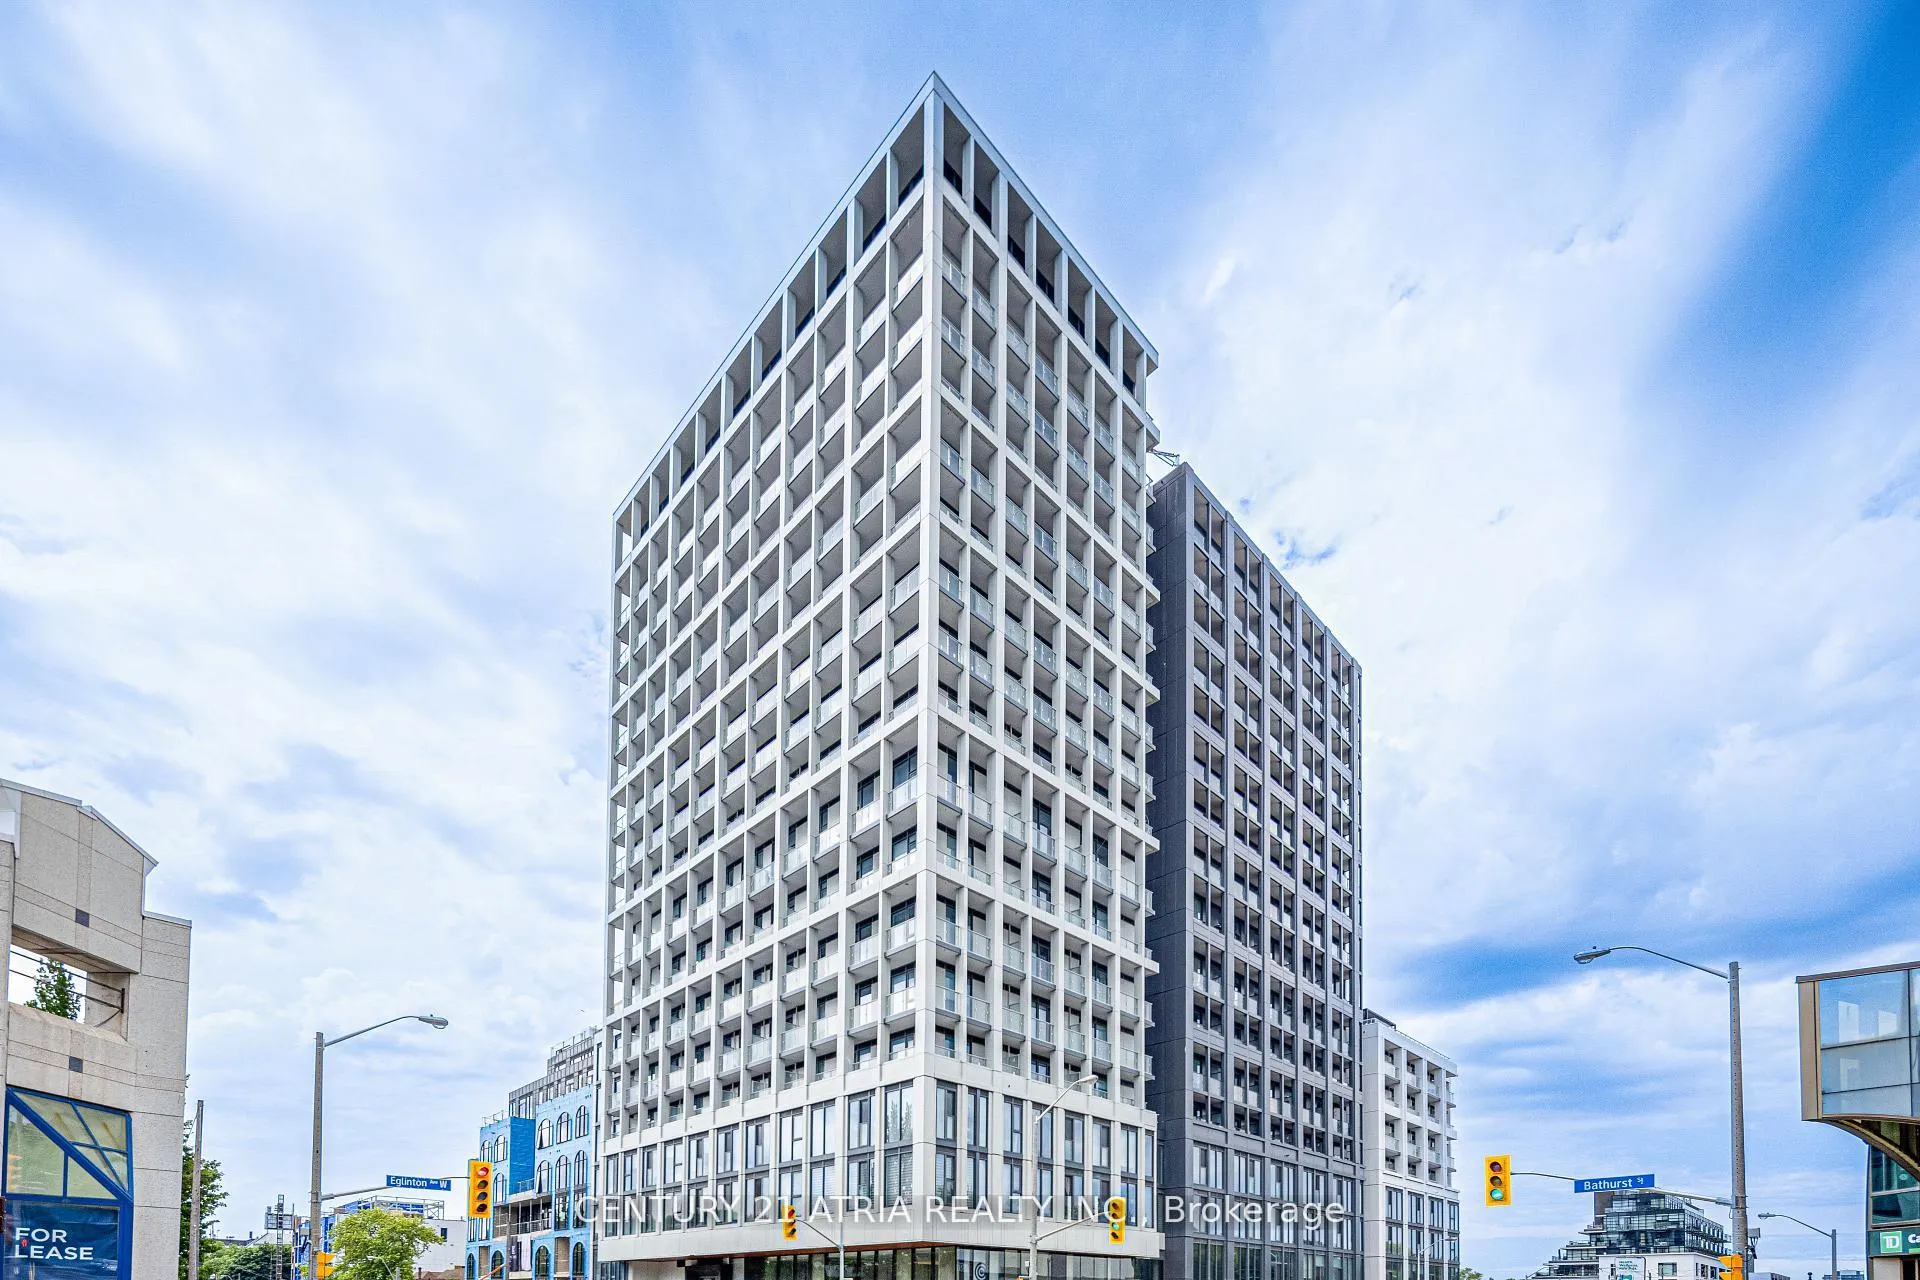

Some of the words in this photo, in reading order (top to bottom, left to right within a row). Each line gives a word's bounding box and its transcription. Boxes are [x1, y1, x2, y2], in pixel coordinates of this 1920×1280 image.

[390, 1177, 428, 1187] Eglinton
[440, 1180, 448, 1189] W
[1583, 1178, 1633, 1191] Bathurst
[1636, 1177, 1644, 1185] St
[15, 1227, 68, 1243] FOR
[1882, 1235, 1901, 1249] TD
[15, 1244, 95, 1260] LEASE
